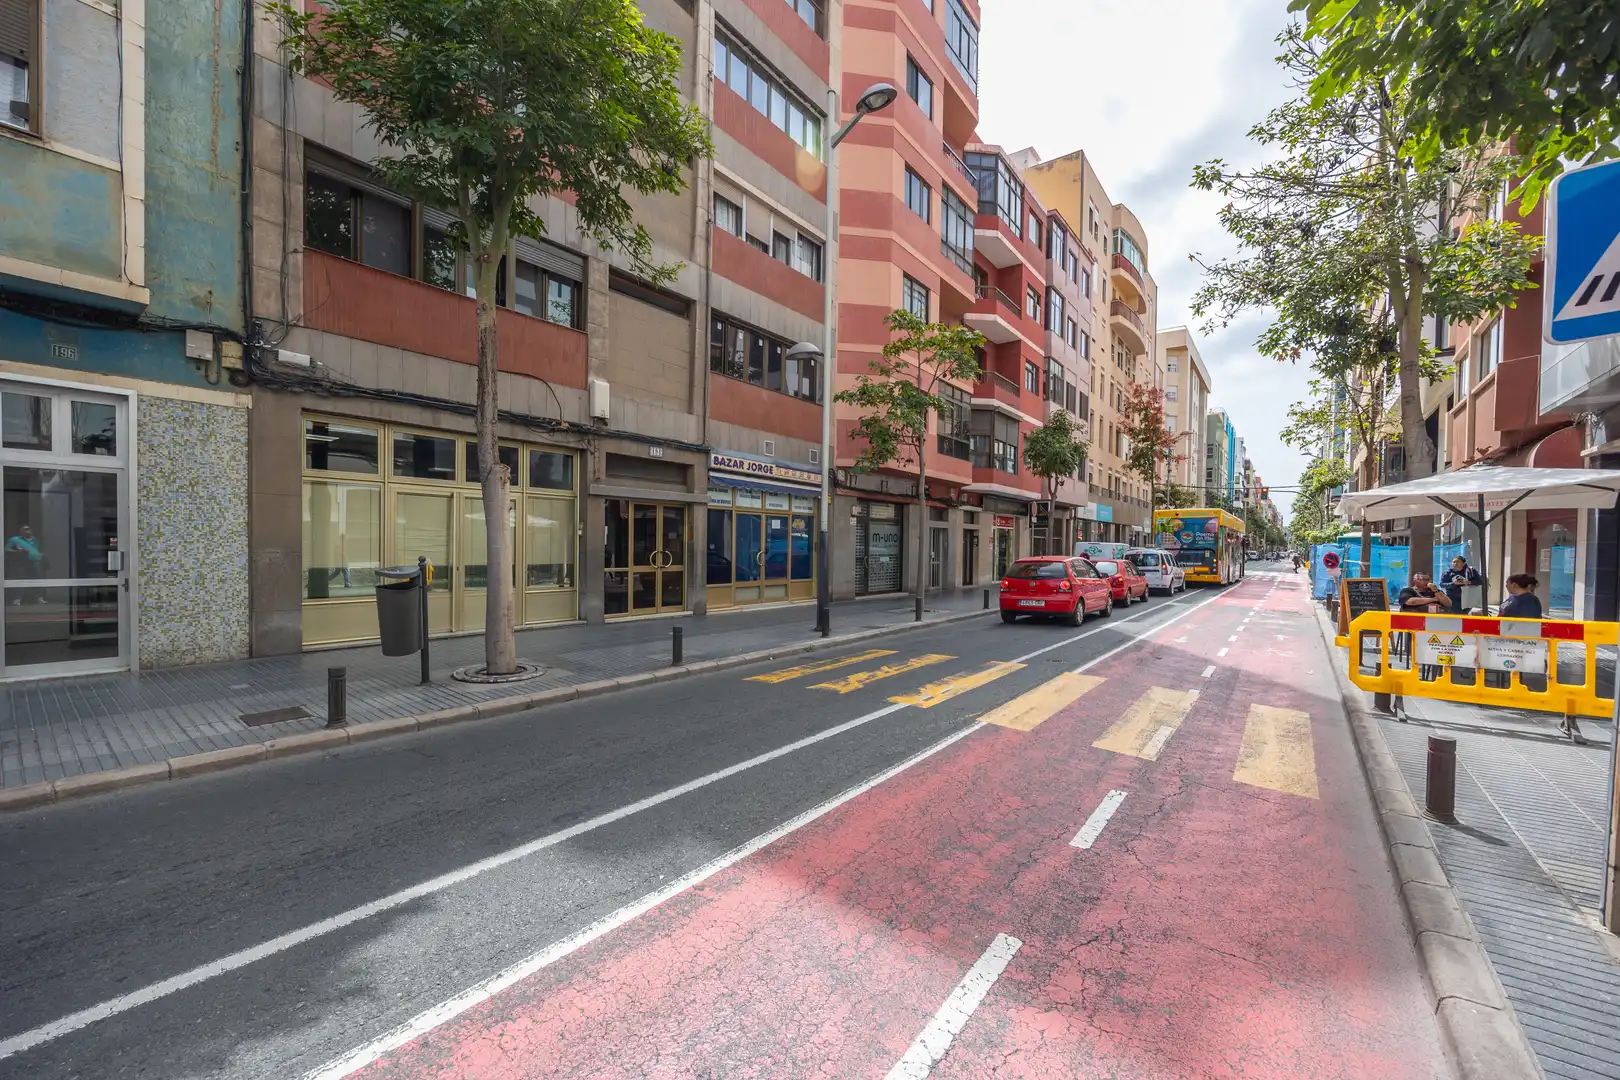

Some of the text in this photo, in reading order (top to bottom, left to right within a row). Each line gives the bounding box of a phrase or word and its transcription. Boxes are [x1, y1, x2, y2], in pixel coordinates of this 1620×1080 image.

[55, 346, 75, 359] 196
[713, 455, 744, 469] BAZAR
[747, 462, 774, 474] JORGE
